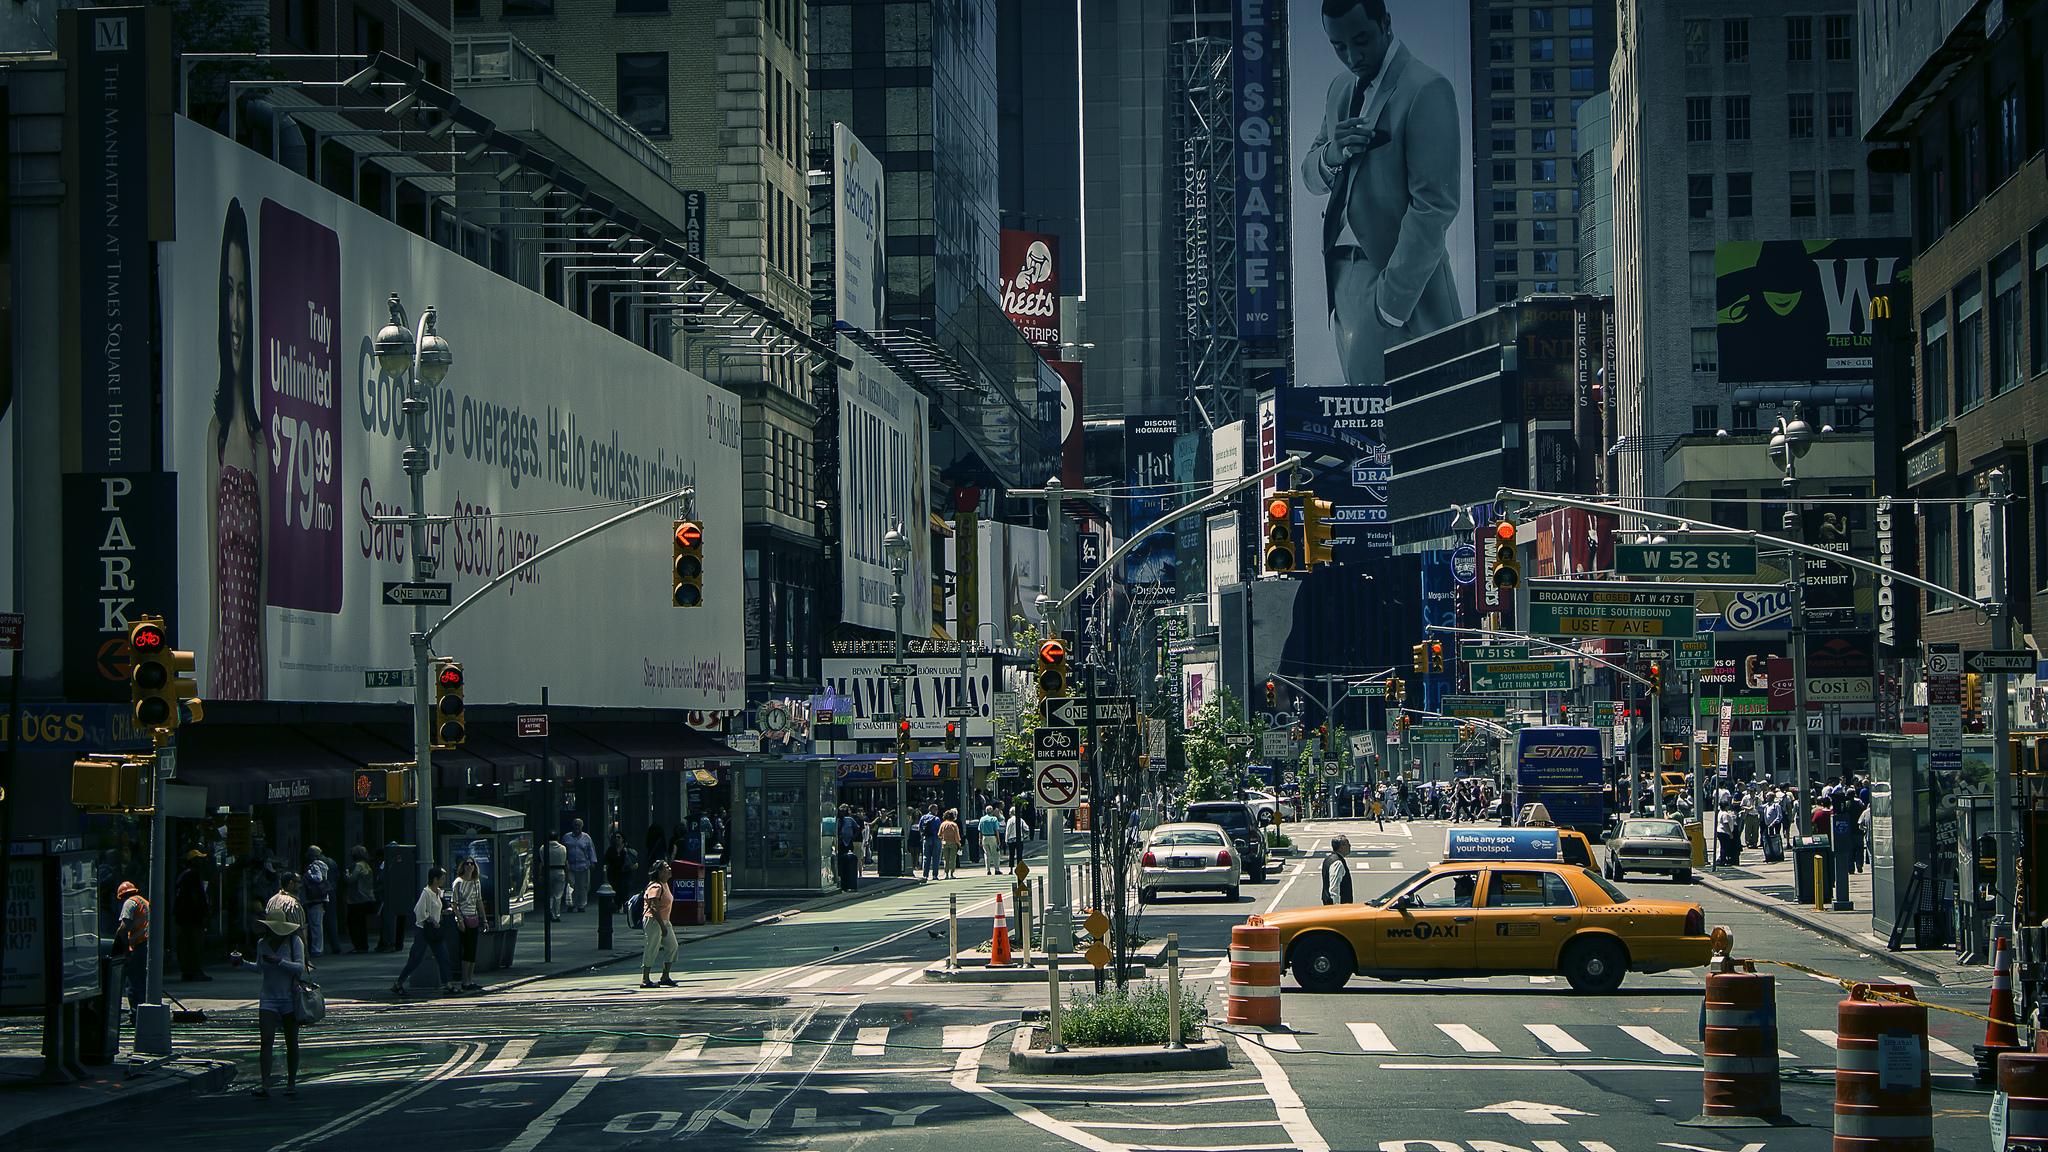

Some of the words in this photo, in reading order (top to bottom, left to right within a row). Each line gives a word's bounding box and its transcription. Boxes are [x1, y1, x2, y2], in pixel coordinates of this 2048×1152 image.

[1241, 0, 1265, 60] ES
[104, 64, 119, 102] THE
[103, 108, 119, 227] MANHATTAN
[1184, 139, 1196, 209] EAGLE
[1239, 83, 1272, 288] SQUARE
[687, 193, 700, 254] STARB
[105, 233, 120, 255] AT
[1197, 168, 1209, 307] OUTFITTERS
[1186, 216, 1198, 336] AMERICAN
[106, 259, 121, 318] TIMES
[1000, 277, 1055, 316] heets
[1246, 313, 1269, 321] NYC
[308, 300, 331, 353] Truly
[1023, 327, 1059, 340] STRIPS
[1826, 336, 1851, 346] THE
[105, 321, 121, 396] SQUARE
[1578, 312, 1589, 407] HERSHEYS
[271, 337, 332, 408] Unlimited
[359, 336, 455, 470] Goobye
[462, 395, 541, 489] overages.
[547, 404, 584, 491] Hello
[590, 430, 639, 505] endless
[1333, 419, 1369, 428] APRIL
[1370, 419, 1384, 428] 28
[108, 404, 122, 467] HOTEL
[1368, 510, 1387, 519] TO
[360, 478, 404, 564] Save
[453, 490, 492, 582] $350
[497, 526, 505, 577] a
[1324, 537, 1356, 545] ESPN
[99, 477, 136, 632] PARK
[1643, 551, 1660, 568] W
[1669, 551, 1699, 568] 52
[1707, 551, 1732, 568] St
[1806, 560, 1827, 569] THE
[1806, 576, 1849, 586] EXHIBIT
[393, 588, 413, 598] ONE
[426, 588, 442, 598] WAY
[1428, 592, 1449, 601] Morgan
[1539, 592, 1589, 601] BROADWAY
[1594, 593, 1630, 602] CLOSED
[1634, 594, 1646, 603] AT
[1649, 594, 1658, 603] W
[1660, 594, 1672, 603] 47
[1674, 594, 1685, 603] ST
[1552, 606, 1574, 615] BEST
[1578, 607, 1606, 616] ROUTE
[1610, 608, 1671, 617] SOUTHBOUND
[1572, 619, 1600, 632] USE
[1607, 620, 1614, 632] 7
[1623, 620, 1651, 632] AVE
[1488, 649, 1500, 657] 51
[1503, 649, 1516, 657] St
[1975, 657, 1995, 667] ONE
[2005, 657, 2027, 667] WAY
[367, 673, 374, 685] W
[378, 673, 388, 685] 52
[391, 672, 400, 680] ST
[1500, 673, 1540, 681] SOUTHBOUND
[825, 677, 926, 719] AMMA
[1064, 706, 1087, 718] ONE
[1100, 706, 1126, 719] WAY
[853, 722, 862, 730] HE
[863, 722, 885, 730] SMASH
[1680, 726, 1691, 734] 24
[1037, 750, 1055, 758] BIKE
[1057, 750, 1077, 758] PATH
[1535, 746, 1587, 758] STARR
[1480, 837, 1497, 845] any
[1497, 836, 1516, 845] spot
[1477, 844, 1512, 853] hotspot.
[676, 880, 695, 888] VOICE
[1388, 928, 1413, 938] NYC
[1414, 922, 1459, 940] TAXI
[601, 1104, 942, 1133] ONLY
